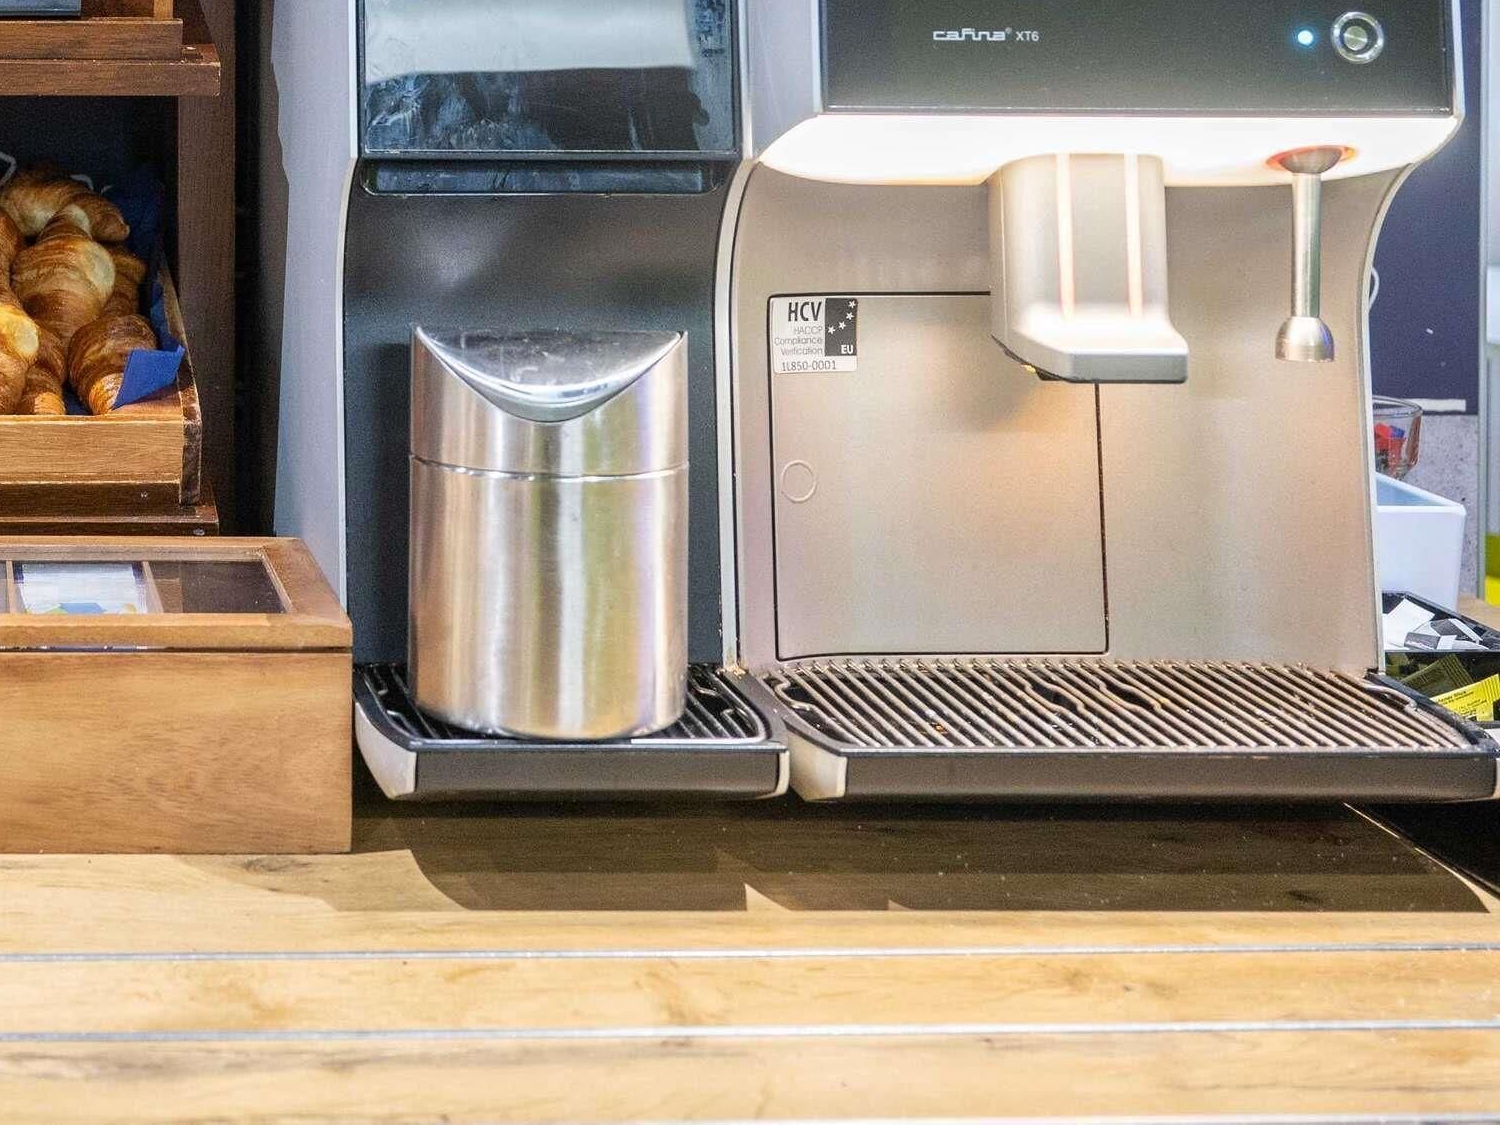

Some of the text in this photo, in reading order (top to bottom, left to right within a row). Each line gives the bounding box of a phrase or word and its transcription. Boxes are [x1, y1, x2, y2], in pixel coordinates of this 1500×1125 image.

[1015, 30, 1040, 42] XT6
[787, 301, 823, 322] HCV
[794, 325, 823, 335] HACCP
[774, 337, 823, 348] Compliance
[780, 347, 823, 356] Verification
[840, 344, 854, 355] EU
